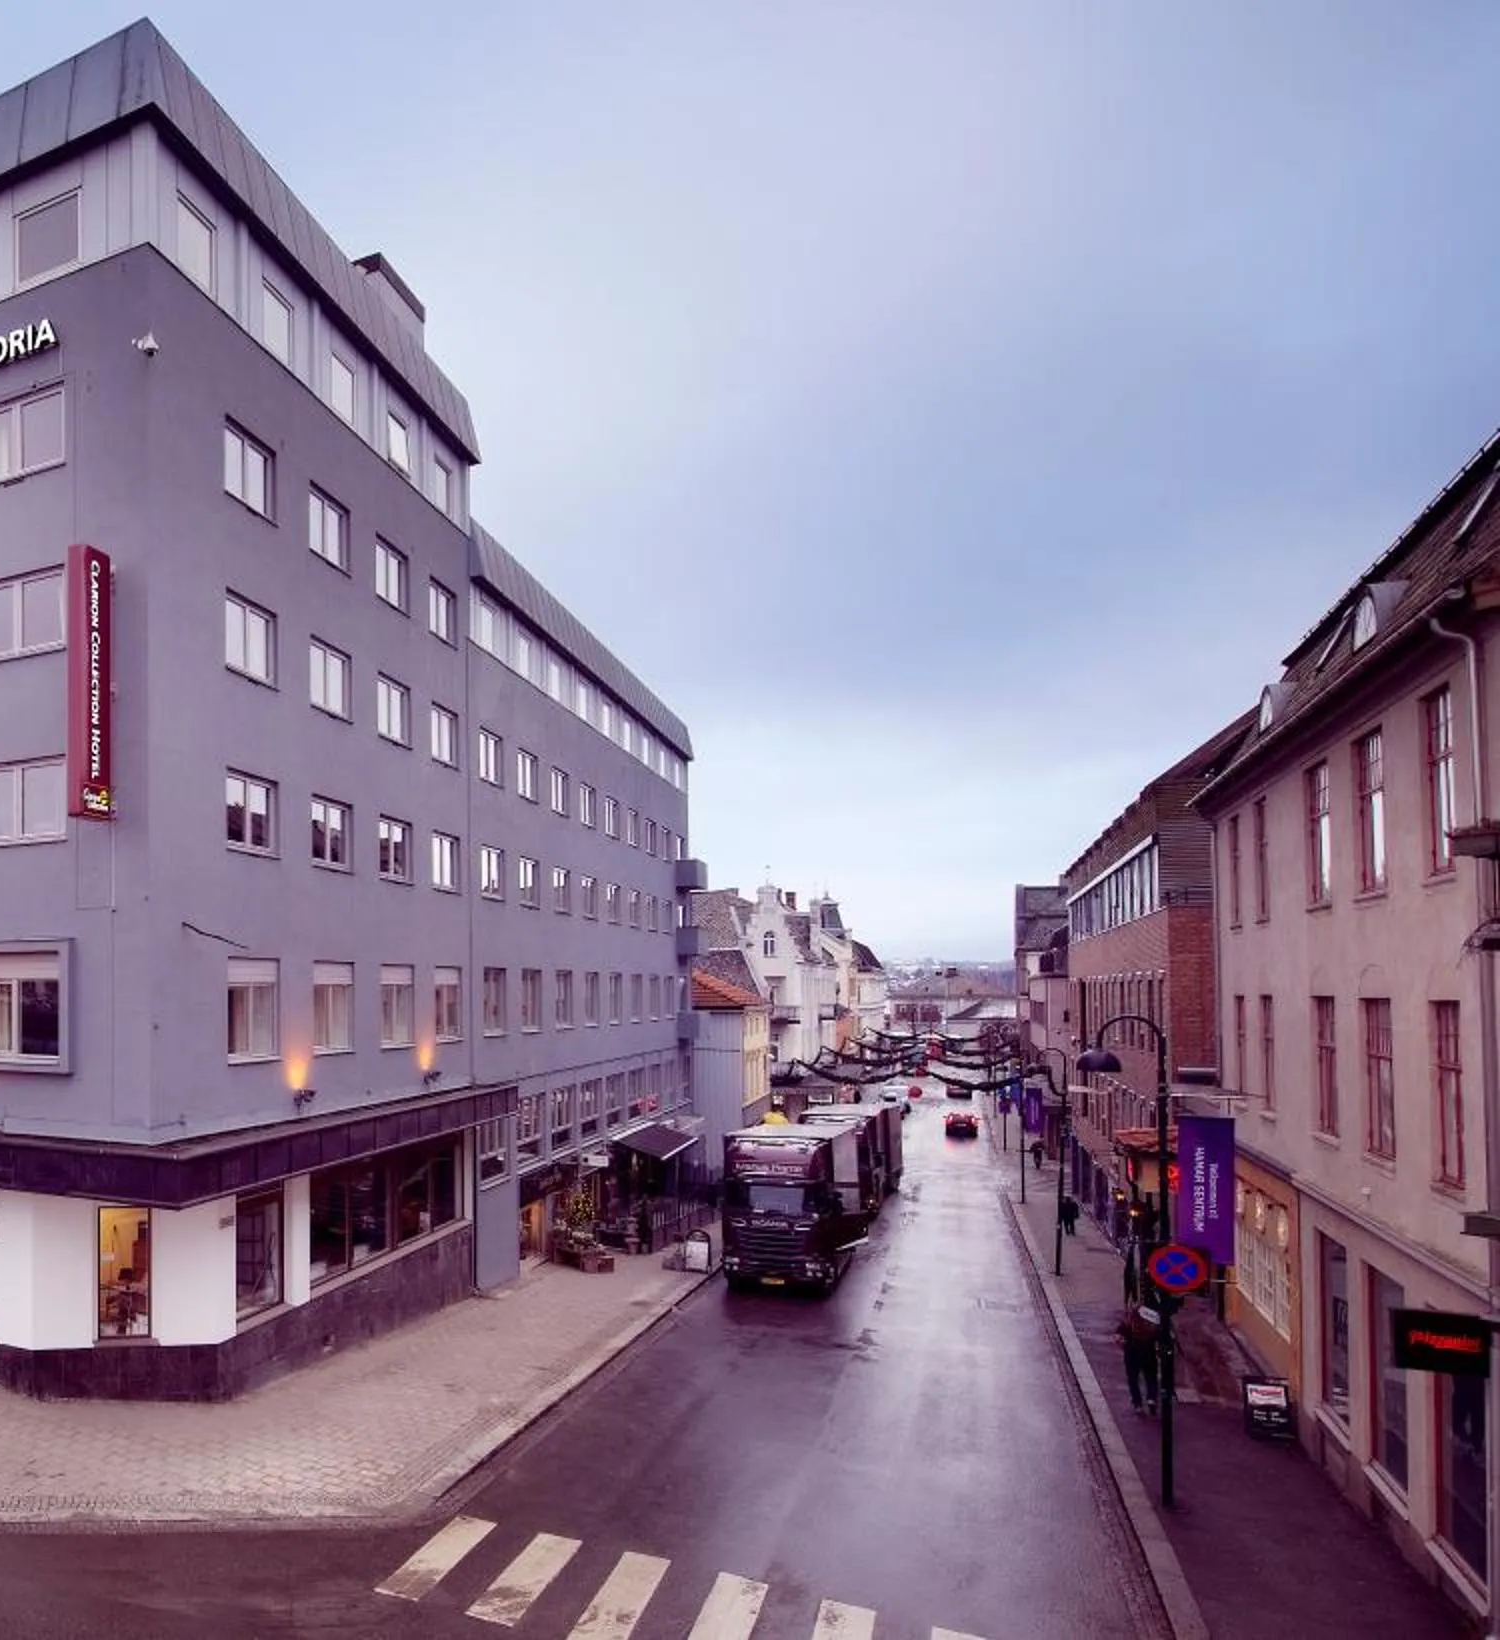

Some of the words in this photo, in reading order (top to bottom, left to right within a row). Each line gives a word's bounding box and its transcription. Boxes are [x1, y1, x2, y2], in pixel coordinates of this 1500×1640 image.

[89, 559, 101, 628] CLARION
[89, 631, 102, 726] COLLECTION
[89, 727, 102, 779] HOTEL
